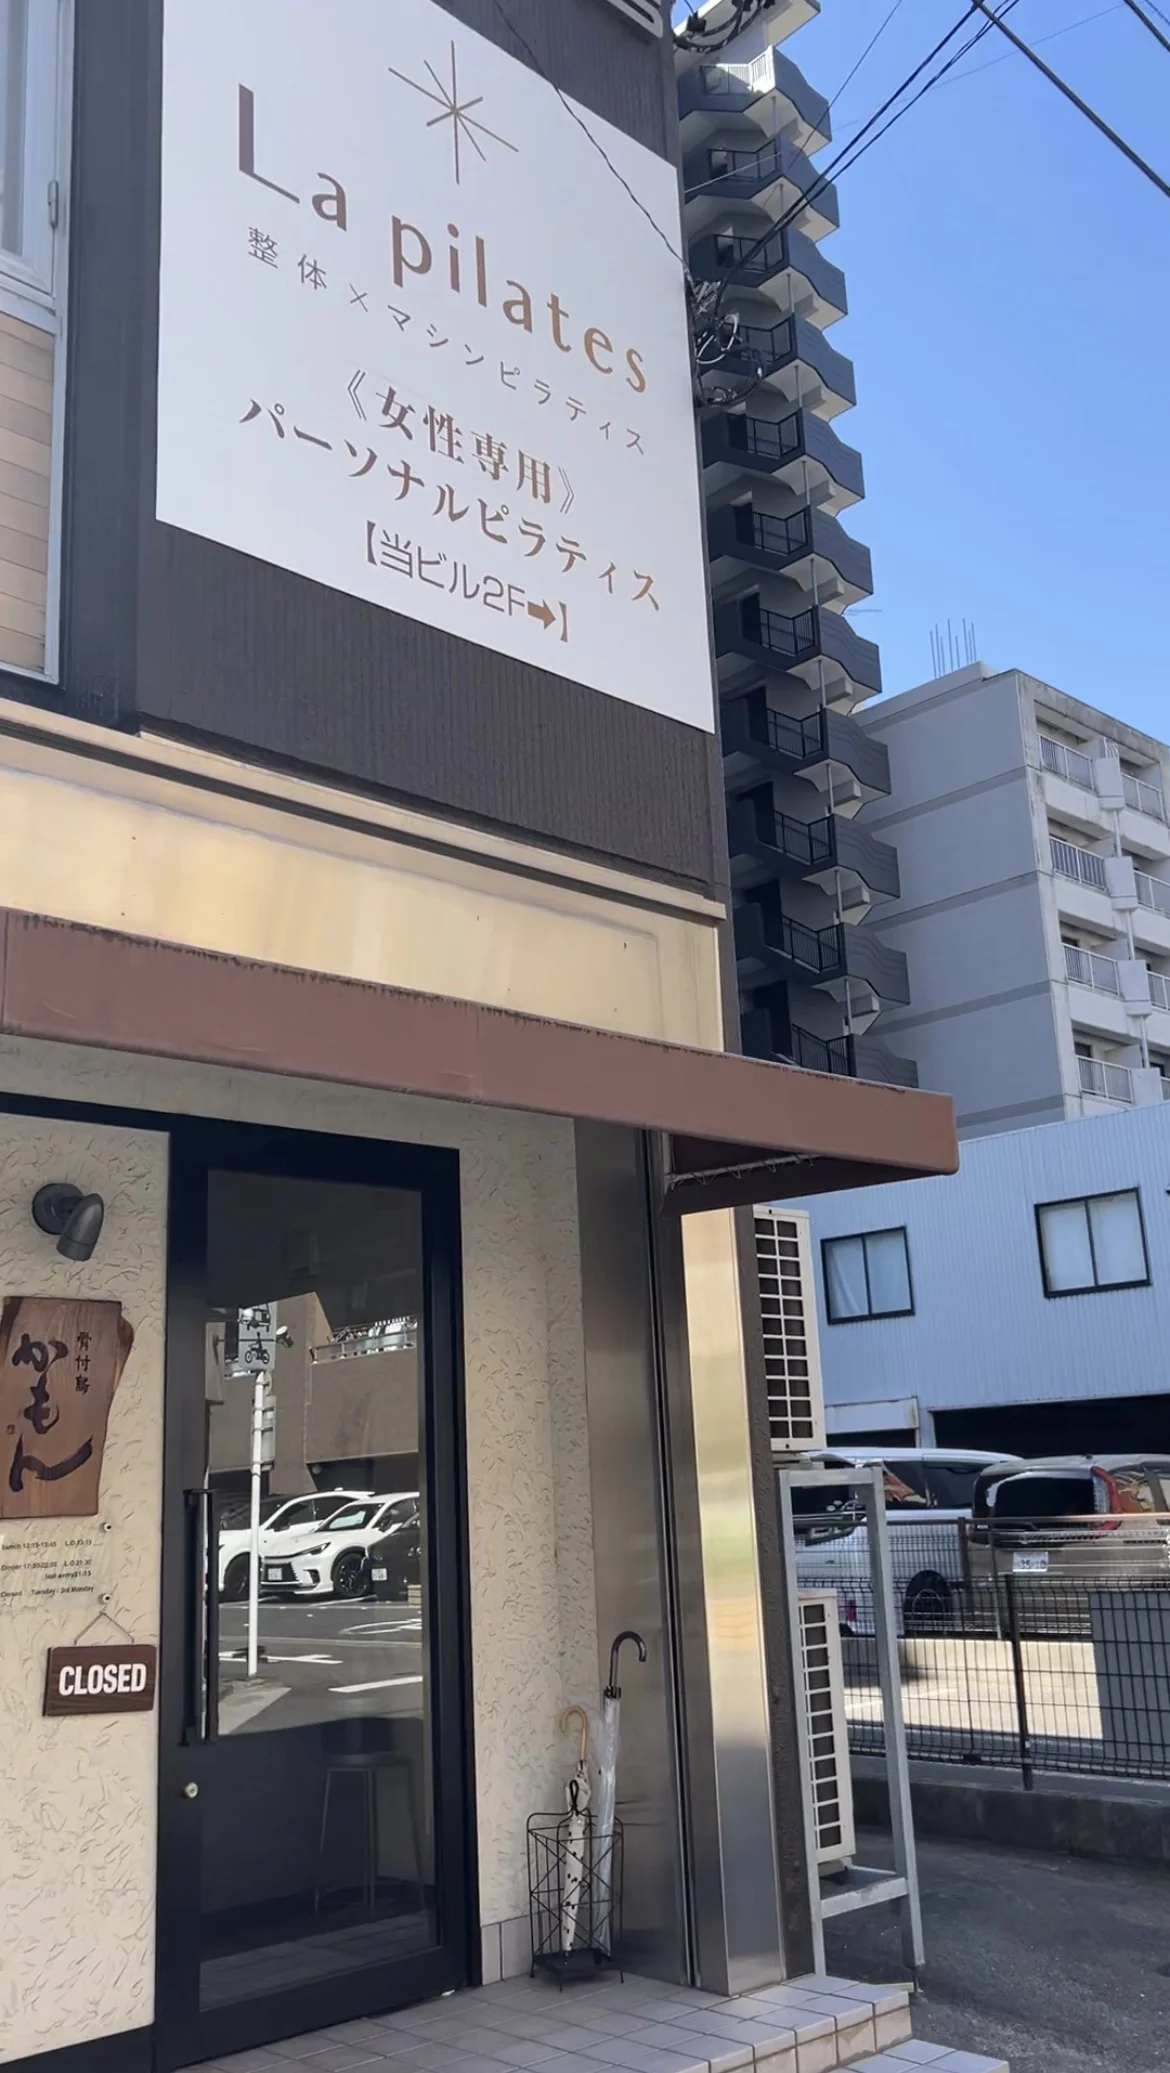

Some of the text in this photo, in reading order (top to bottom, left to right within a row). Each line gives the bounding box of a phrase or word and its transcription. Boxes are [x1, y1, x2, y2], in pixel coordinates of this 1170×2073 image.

[237, 83, 647, 394] La pilates
[238, 398, 661, 611] パーソナルピラティス
[9, 1332, 93, 1492] かもん
[75, 1331, 92, 1395] 骨付鳥
[58, 1663, 147, 1696] CLOSED
